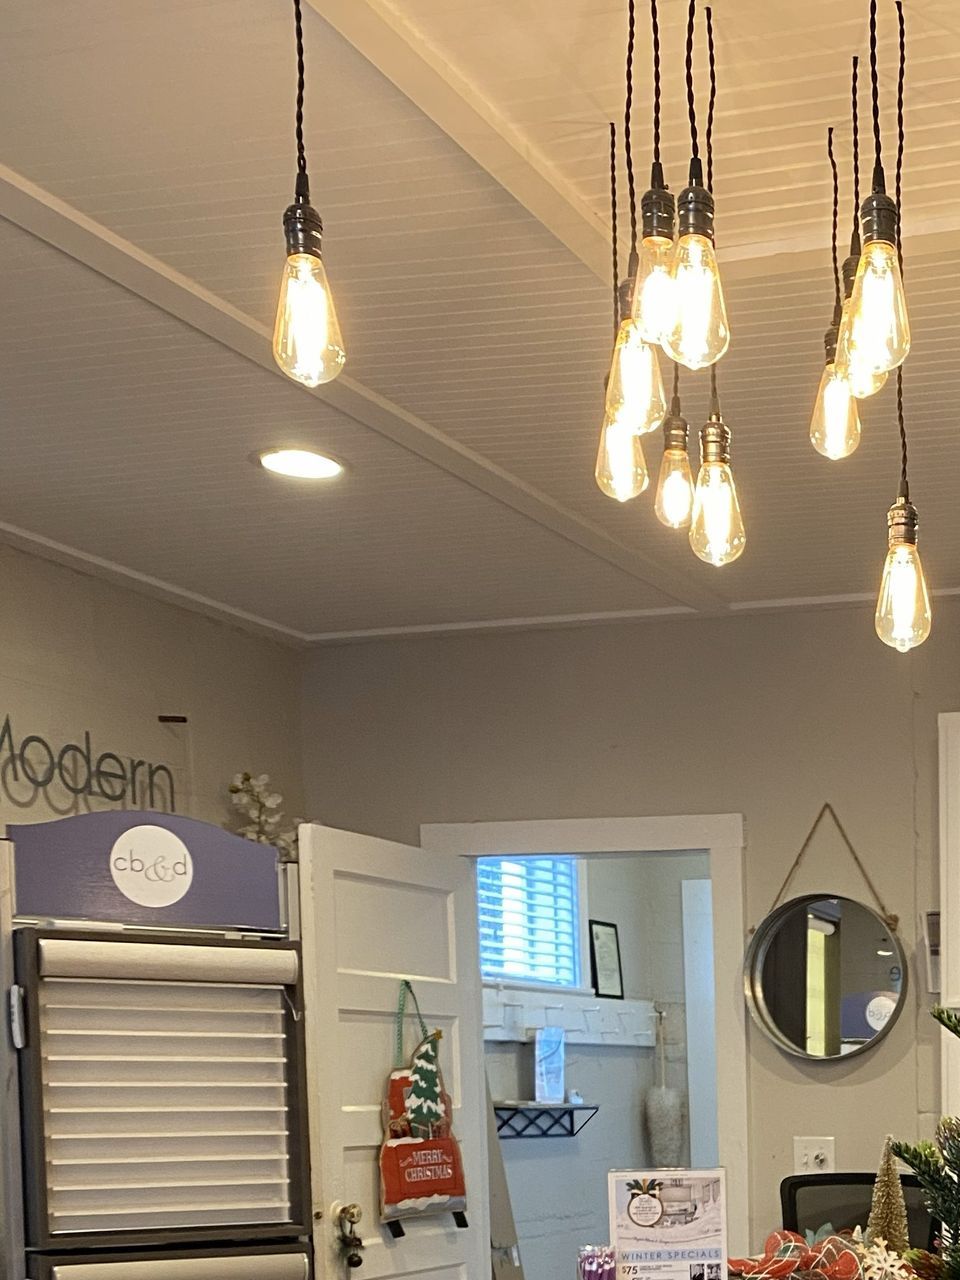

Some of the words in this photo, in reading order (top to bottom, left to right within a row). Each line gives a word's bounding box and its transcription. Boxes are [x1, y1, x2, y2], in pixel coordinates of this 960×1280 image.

[412, 1149, 444, 1165] MERRY
[405, 1164, 453, 1183] CHRISTMAS
[621, 1251, 663, 1261] WINTER
[667, 1249, 720, 1260] SPECIALS
[621, 1265, 638, 1275] $75
